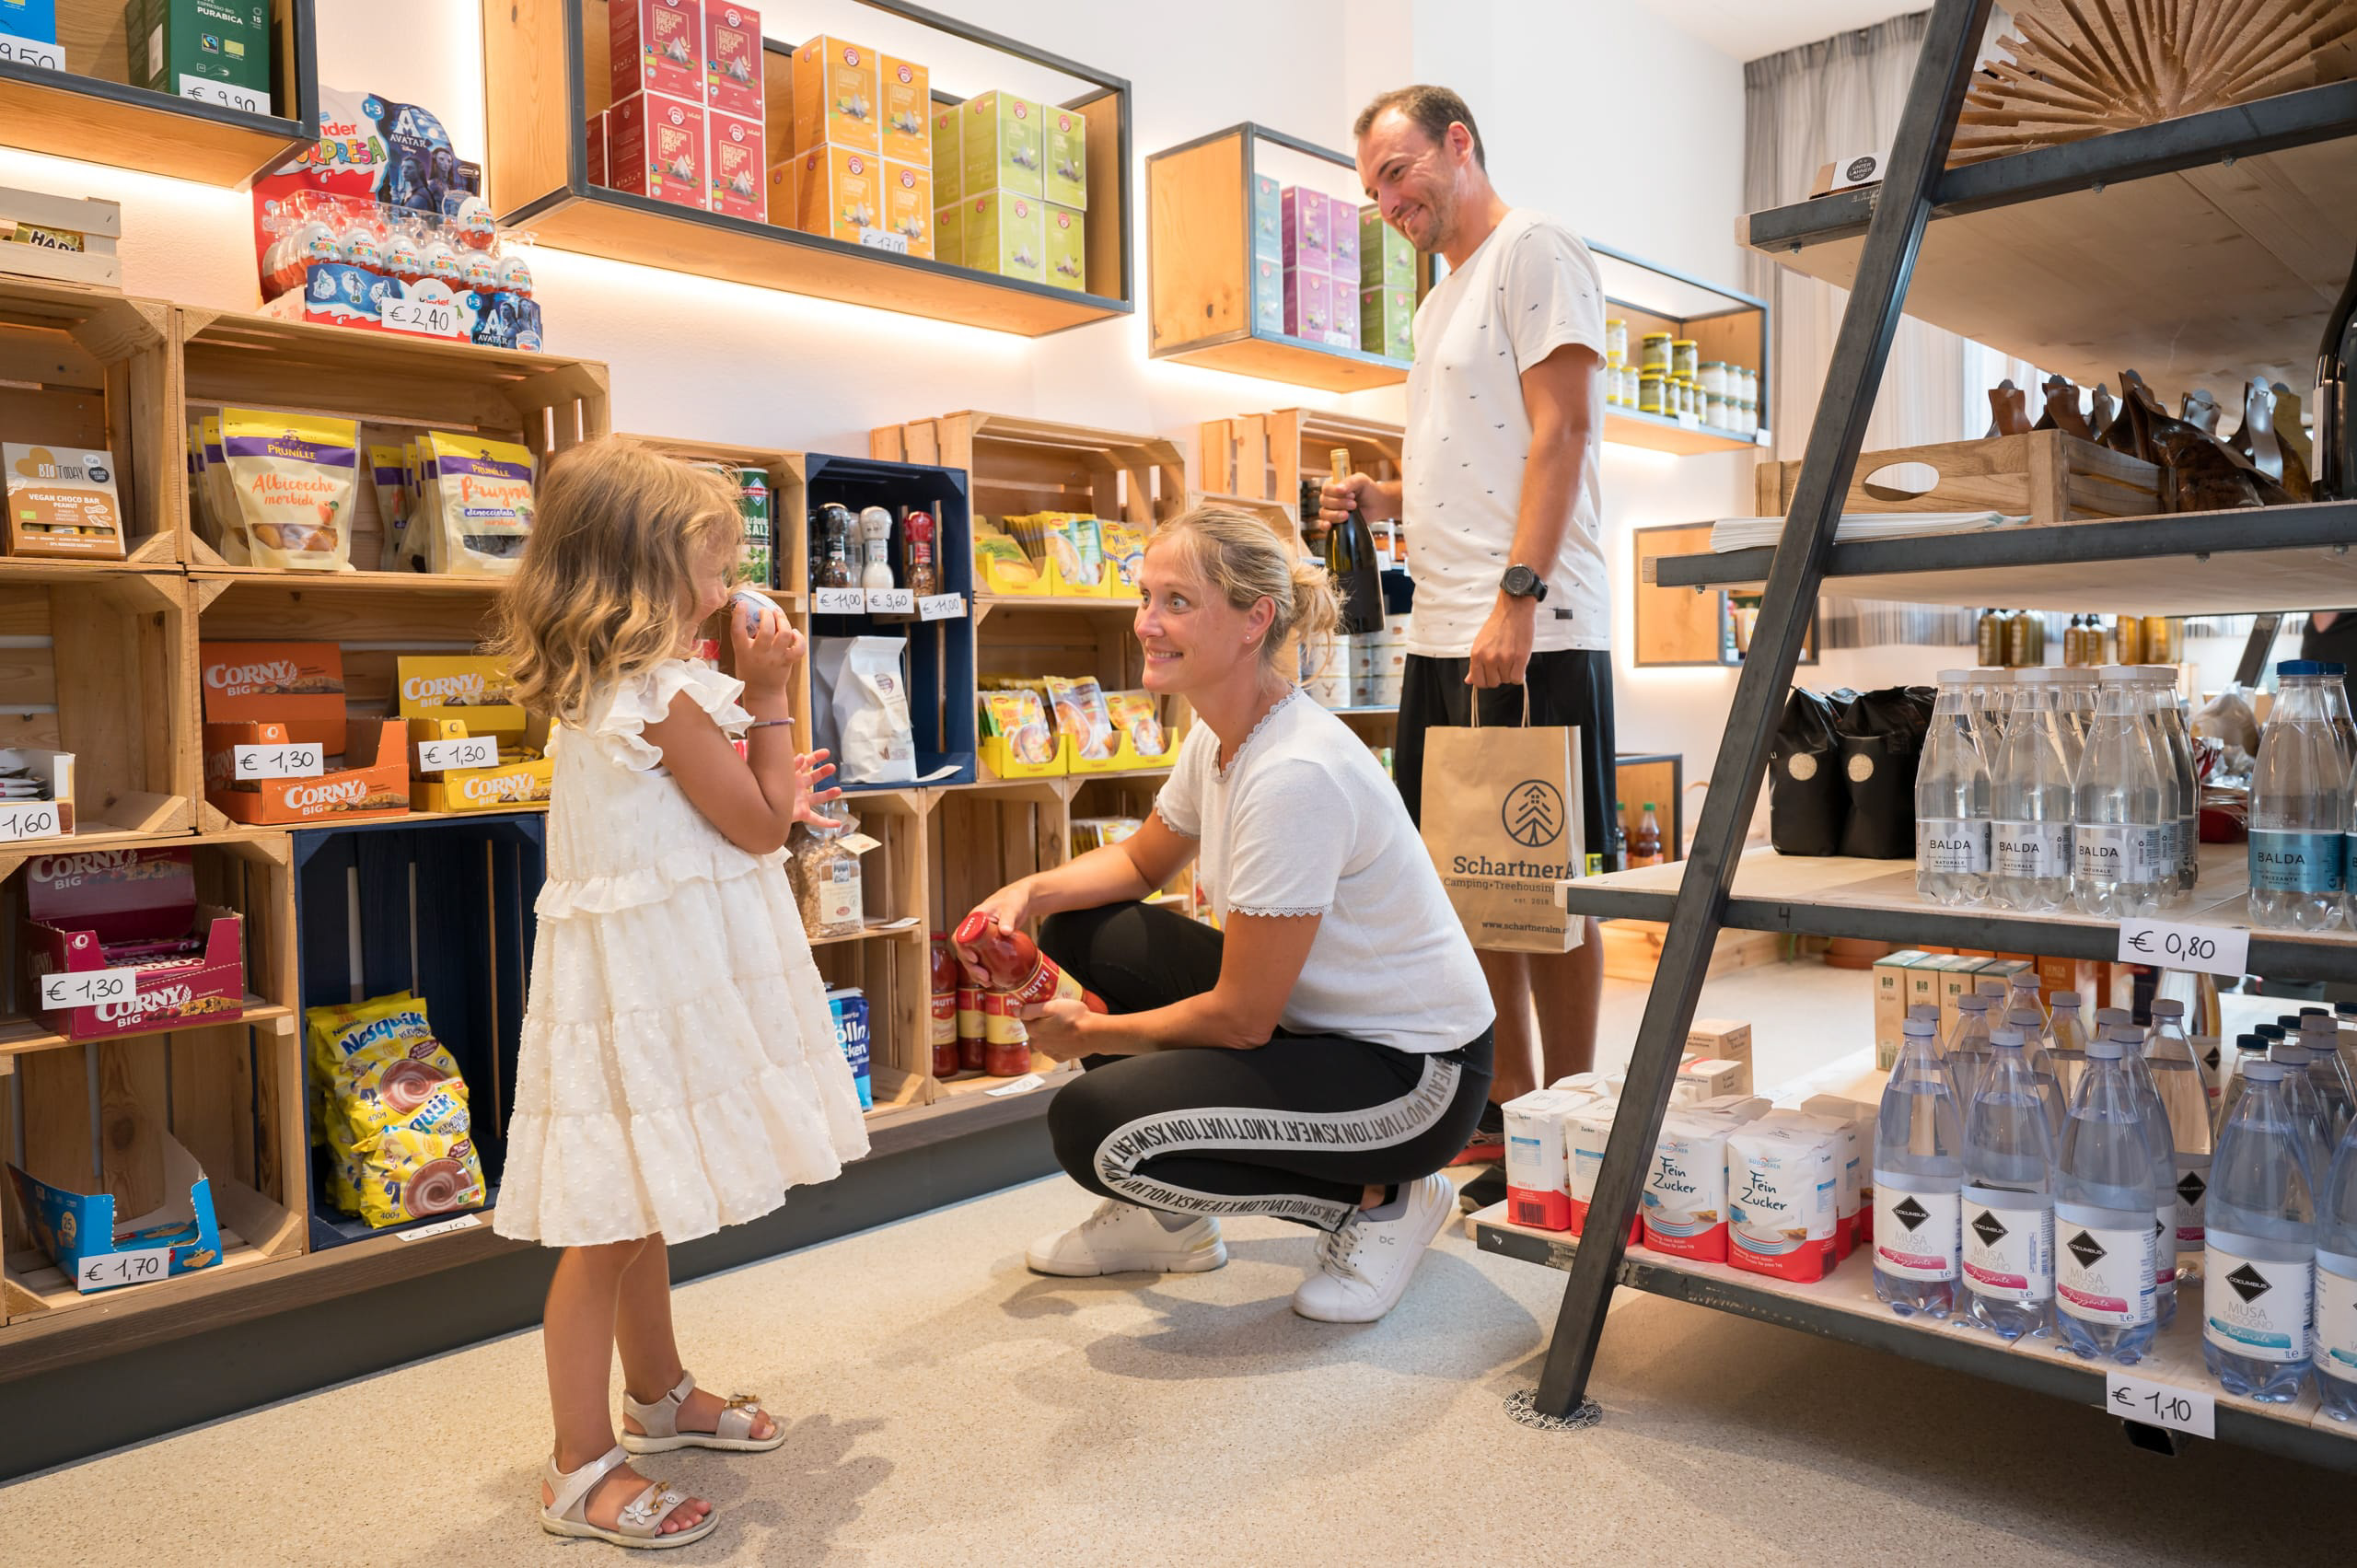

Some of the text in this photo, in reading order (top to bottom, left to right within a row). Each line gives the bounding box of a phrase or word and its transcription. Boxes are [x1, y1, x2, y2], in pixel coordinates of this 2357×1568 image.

[196, 6, 244, 25] PURABICA
[319, 121, 357, 136] nder
[389, 134, 427, 149] AVATAR
[389, 306, 407, 322] €
[411, 307, 449, 331] 2,40
[478, 334, 508, 346] AVATAR
[55, 464, 85, 481] TODAY
[251, 472, 338, 494] Albicocche
[461, 475, 531, 508] Prugne
[29, 493, 100, 505] VEGAN CHOCO BAR
[819, 592, 862, 610] € 11,00
[869, 595, 881, 607] €
[923, 598, 959, 614] € 11,00
[205, 659, 290, 690] CORNY
[226, 685, 251, 696] BIG
[403, 672, 477, 702] CORNY
[420, 696, 442, 708] BIG
[239, 750, 315, 773] € 1,30
[424, 745, 486, 766] € 1,30
[284, 779, 361, 809] CORNY
[463, 773, 528, 800] CORNY
[478, 795, 499, 806] BIG
[302, 805, 323, 816] BIG
[1, 811, 52, 839] 1,60
[1930, 839, 1971, 850] BALDA
[1999, 842, 2040, 854] BALDA
[2078, 845, 2119, 857] BALDA
[29, 849, 126, 884] CORNY
[2258, 852, 2305, 865] BALDA
[54, 875, 82, 890] BIG
[2128, 930, 2216, 962] € 0,80
[46, 978, 123, 1002] € 1,30
[1021, 970, 1050, 999] MUTTI
[94, 984, 186, 1023] CORNY
[117, 1013, 142, 1028] BIG
[340, 1011, 427, 1056] Nesquik
[835, 1019, 867, 1043] ölln
[1660, 1156, 1687, 1178] Fein
[1652, 1172, 1697, 1194] Zucker
[1749, 1170, 1777, 1194] Fein
[1740, 1186, 1788, 1211] Zucker
[380, 1212, 401, 1220] 400g
[1895, 1229, 1928, 1246] MUSA
[1891, 1251, 1933, 1267] Frizzante
[1973, 1246, 2005, 1262] MUSA
[84, 1257, 159, 1282] € 1,70
[1970, 1266, 2011, 1284] Frizzante
[2071, 1266, 2105, 1285] MUSA
[2068, 1289, 2111, 1308] Frizzante
[2228, 1300, 2268, 1320] MUSA
[2224, 1325, 2270, 1343] Naturale
[2111, 1387, 2192, 1422] € 1,10
